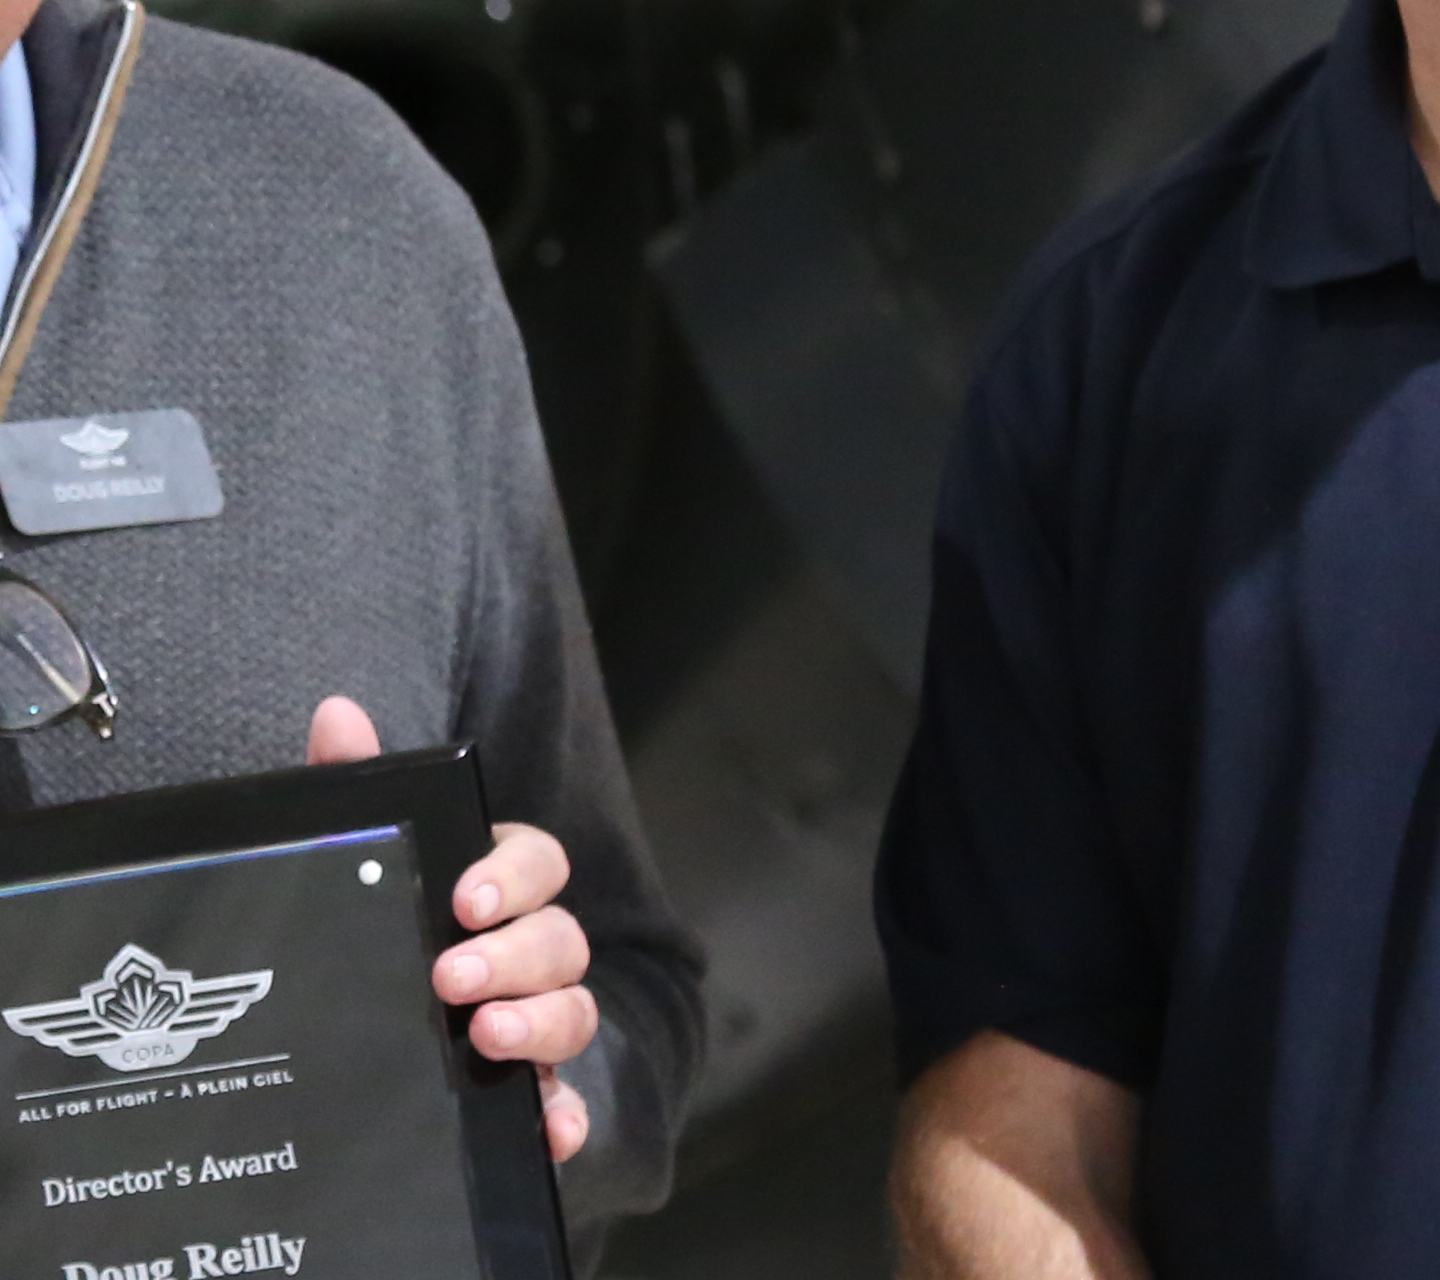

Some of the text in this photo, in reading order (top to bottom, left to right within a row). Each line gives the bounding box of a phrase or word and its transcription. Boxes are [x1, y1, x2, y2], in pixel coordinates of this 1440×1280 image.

[122, 1043, 175, 1064] COPA
[19, 1107, 52, 1123] ALL
[56, 1100, 92, 1117] FOR
[96, 1089, 158, 1111] FLIGHT
[197, 1076, 248, 1095] PLEIN
[253, 1071, 293, 1087] CIEL
[42, 1142, 298, 1206] Director's Award
[184, 1232, 306, 1280] Reilly
